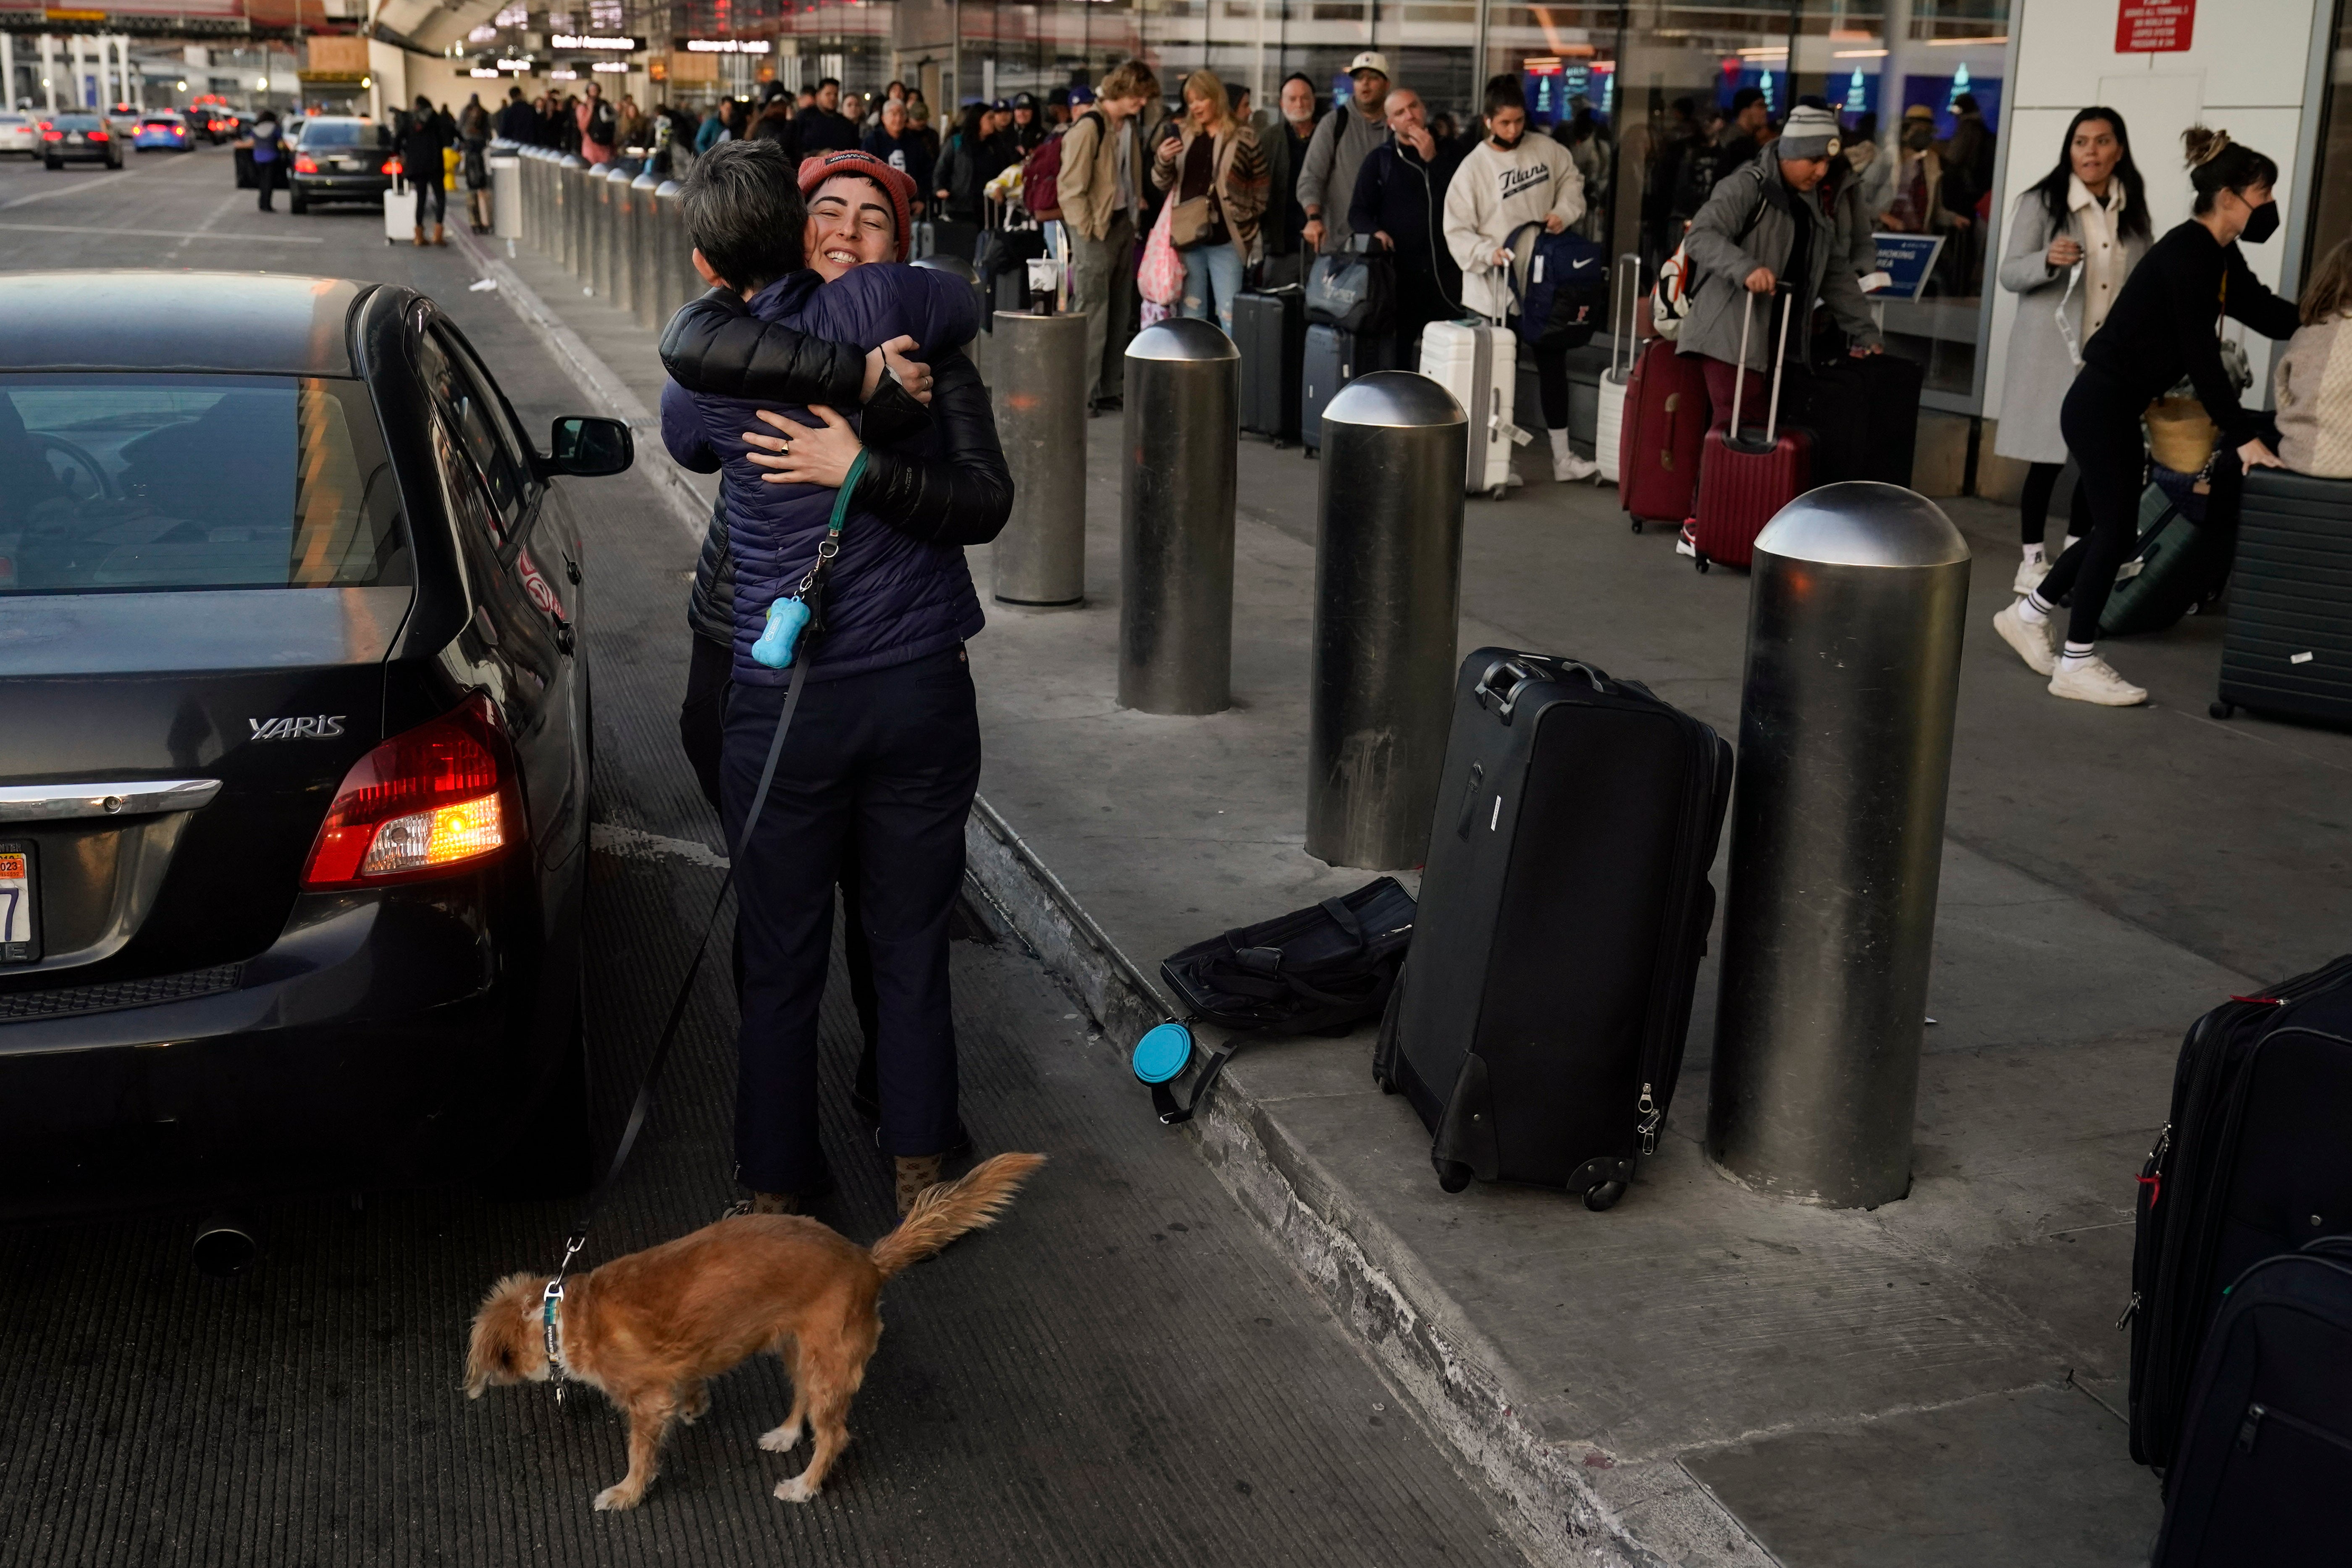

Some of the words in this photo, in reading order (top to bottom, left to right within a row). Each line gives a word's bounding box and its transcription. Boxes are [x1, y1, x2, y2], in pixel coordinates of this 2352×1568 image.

[1499, 163, 1549, 190] Titans
[1877, 249, 1916, 260] MOKING
[1876, 258, 1894, 268] REA
[0, 843, 21, 852] NTER
[0, 861, 18, 871] 023
